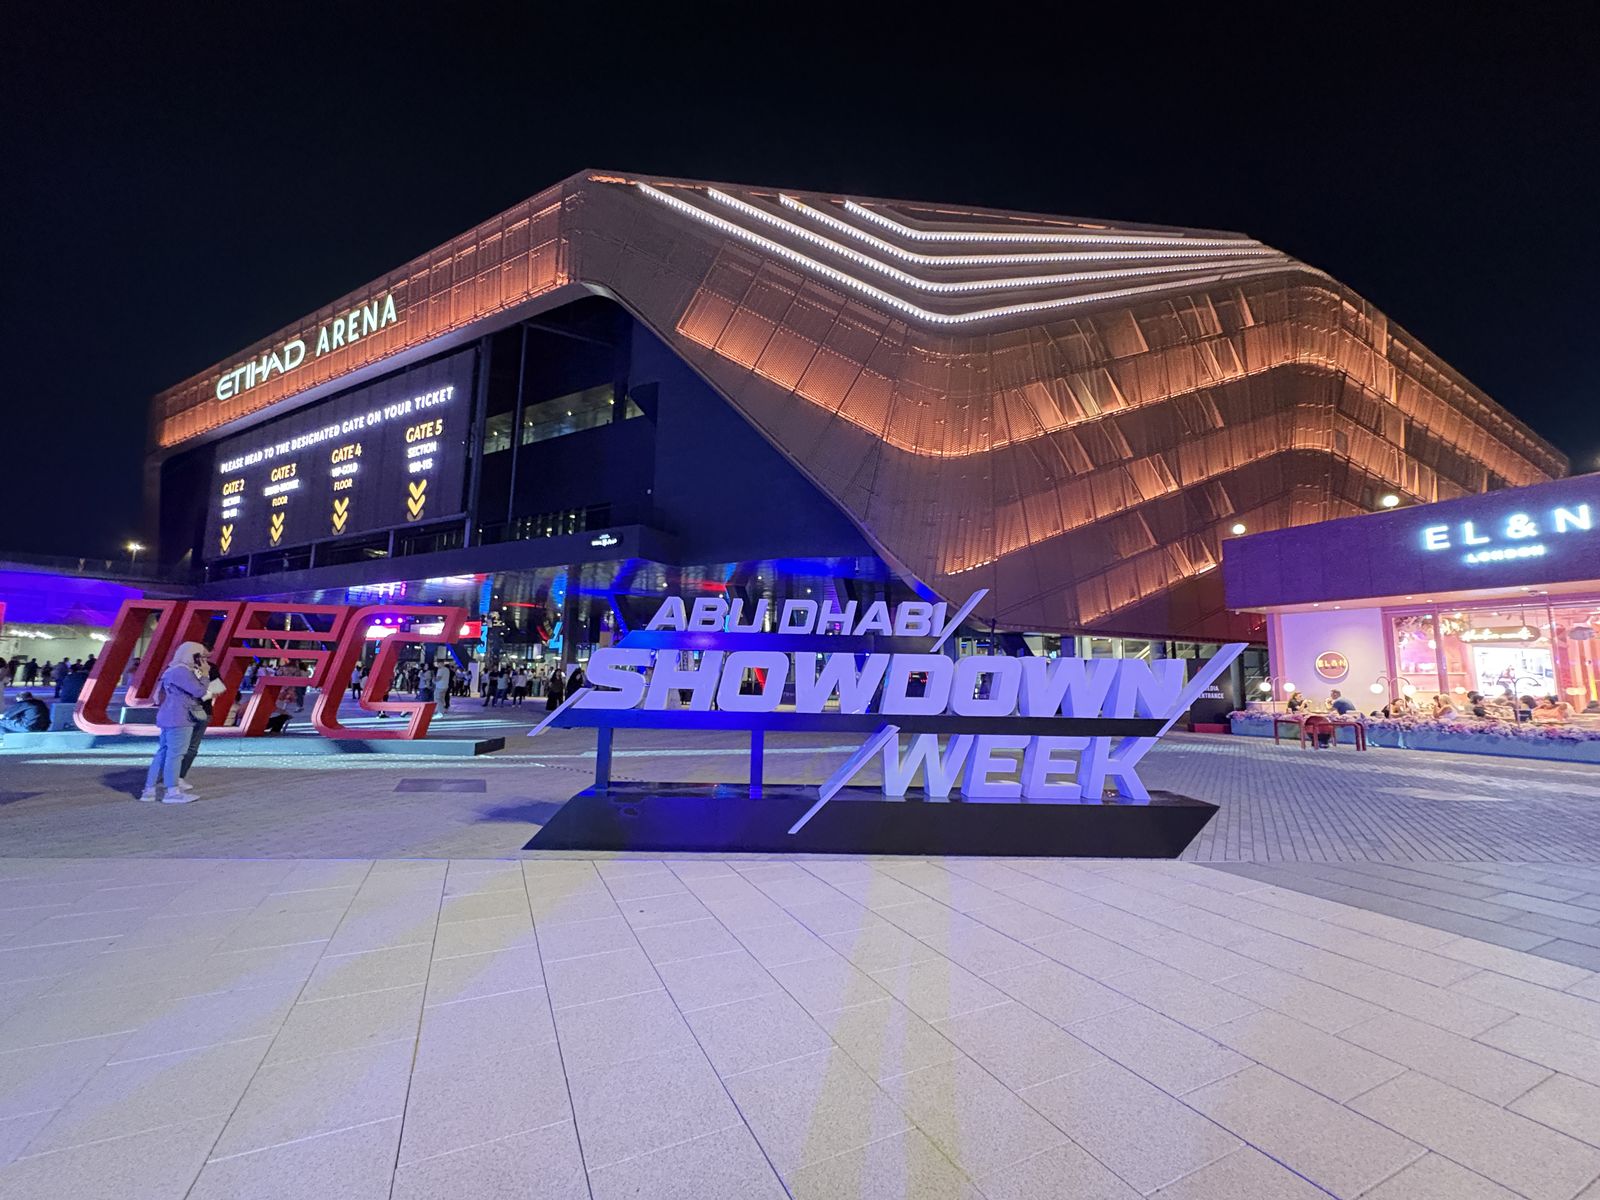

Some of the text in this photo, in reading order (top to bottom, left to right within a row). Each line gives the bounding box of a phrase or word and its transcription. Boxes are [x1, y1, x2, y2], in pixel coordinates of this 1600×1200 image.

[216, 294, 397, 400] ETIHAD ARENA
[221, 386, 454, 474] PLEASE HEAD TO THE DESIGNATED GATE ON YOUR TICKET
[406, 419, 443, 443] GATE 5
[331, 442, 362, 464] GATE 4
[407, 441, 437, 459] SECTION
[271, 463, 297, 482] GATE 3
[223, 478, 245, 496] GATE 2
[333, 478, 353, 492] FLOOR
[272, 495, 288, 508] FLOOR
[645, 596, 948, 638] ABU DHABI
[72, 599, 468, 740] UFC
[571, 647, 1187, 720] SHOWDOWN
[880, 732, 1160, 801] WEEK
